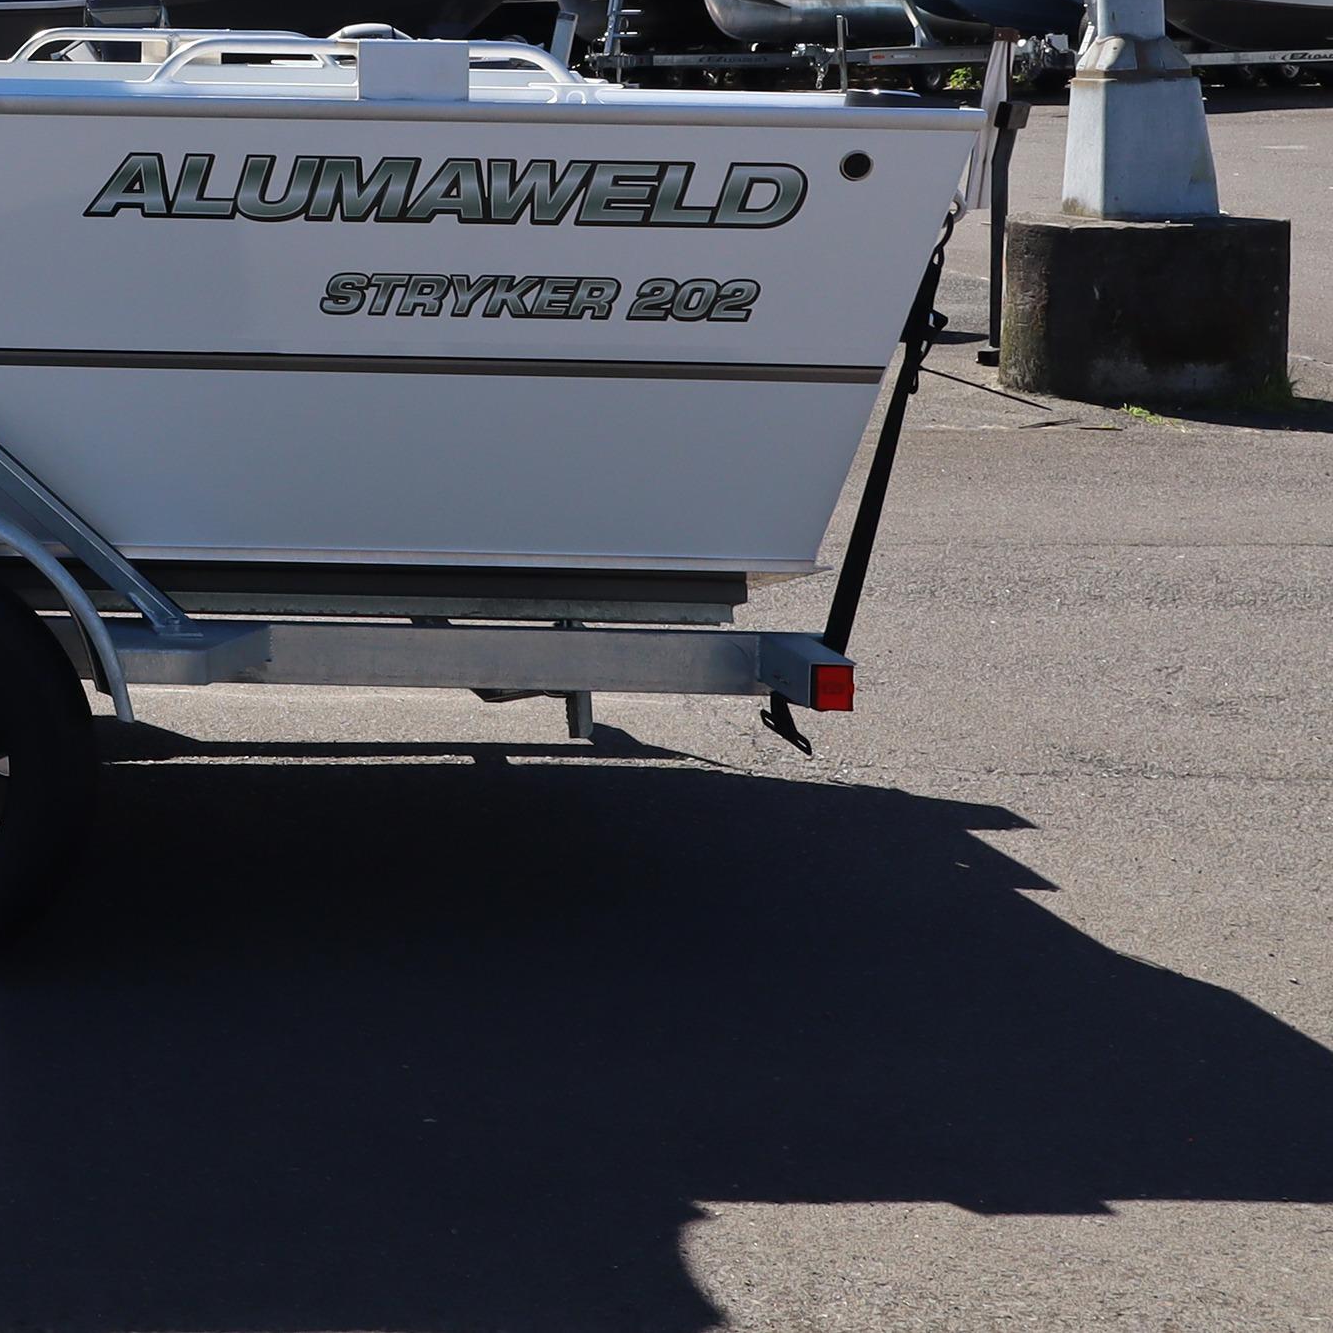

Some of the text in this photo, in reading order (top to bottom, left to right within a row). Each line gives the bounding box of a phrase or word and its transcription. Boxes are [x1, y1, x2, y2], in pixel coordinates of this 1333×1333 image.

[83, 152, 808, 229] ALUMAWELD
[320, 273, 761, 322] STRYKER 202
